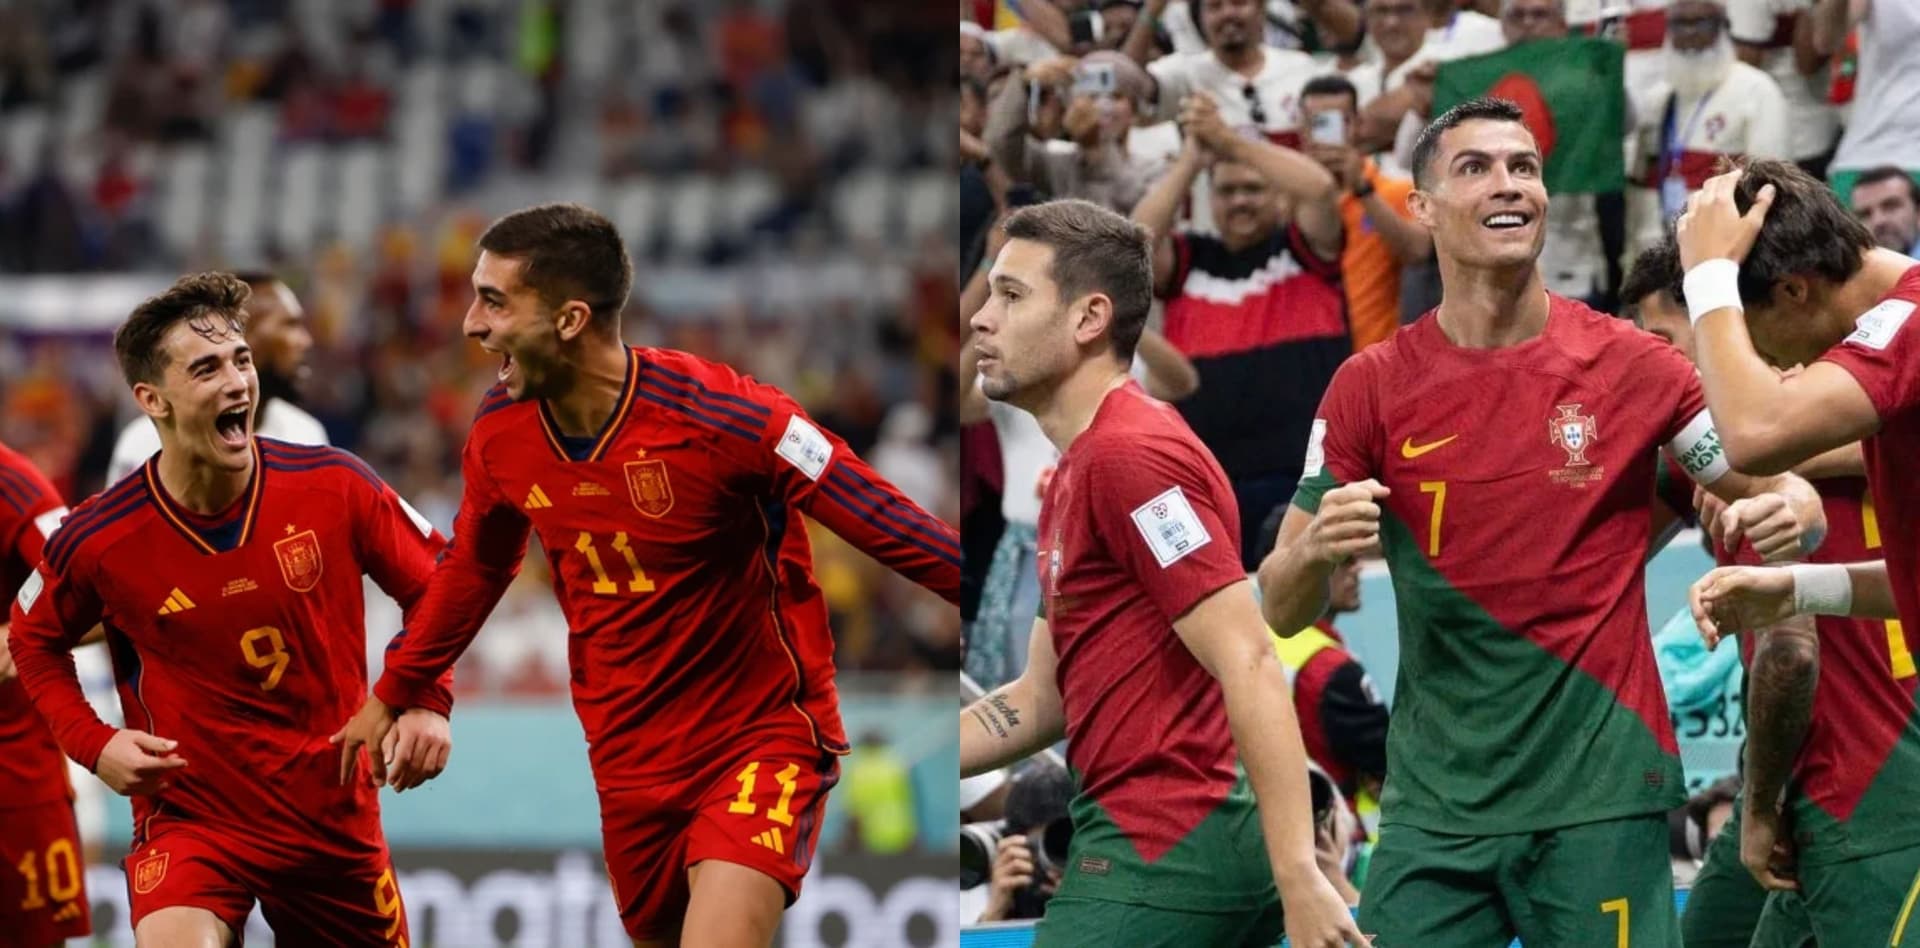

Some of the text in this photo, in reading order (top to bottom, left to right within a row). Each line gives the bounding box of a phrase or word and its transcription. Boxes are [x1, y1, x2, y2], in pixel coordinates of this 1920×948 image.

[1420, 481, 1446, 557] 7
[574, 531, 656, 595] 11
[240, 626, 290, 690] 9
[728, 761, 800, 827] 11
[18, 837, 82, 910] 10
[373, 867, 401, 941] 9
[1601, 897, 1630, 948] 7
